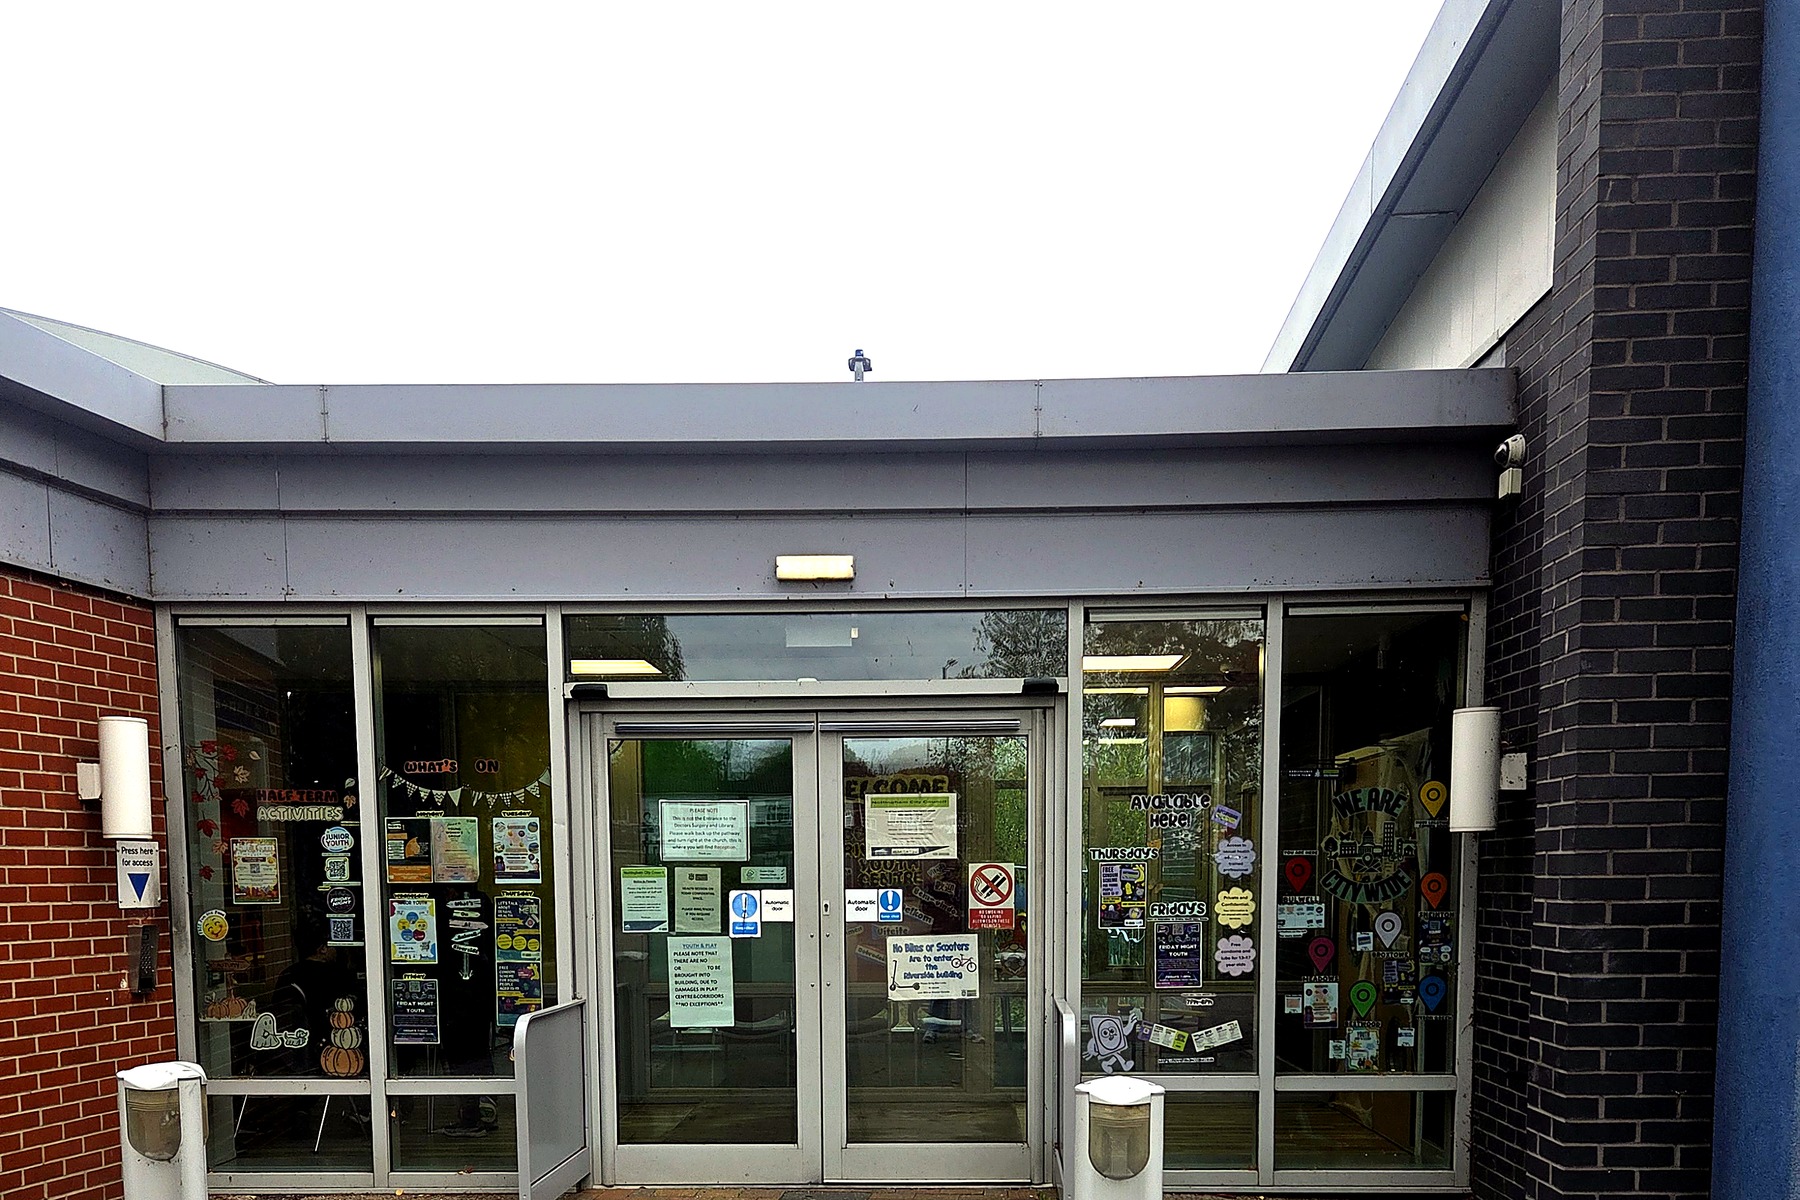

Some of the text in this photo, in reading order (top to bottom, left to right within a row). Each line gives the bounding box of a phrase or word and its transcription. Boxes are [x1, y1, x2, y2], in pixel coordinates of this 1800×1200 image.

[405, 759, 500, 773] WHAT'S ON
[295, 790, 338, 802] TERM
[1332, 788, 1408, 820] WE ARE
[257, 806, 343, 821] ACTIVITIES
[121, 846, 154, 855] Press here
[122, 857, 131, 867] for
[892, 942, 970, 953] No Bikes or Scooters
[904, 970, 963, 980] Riverside building
